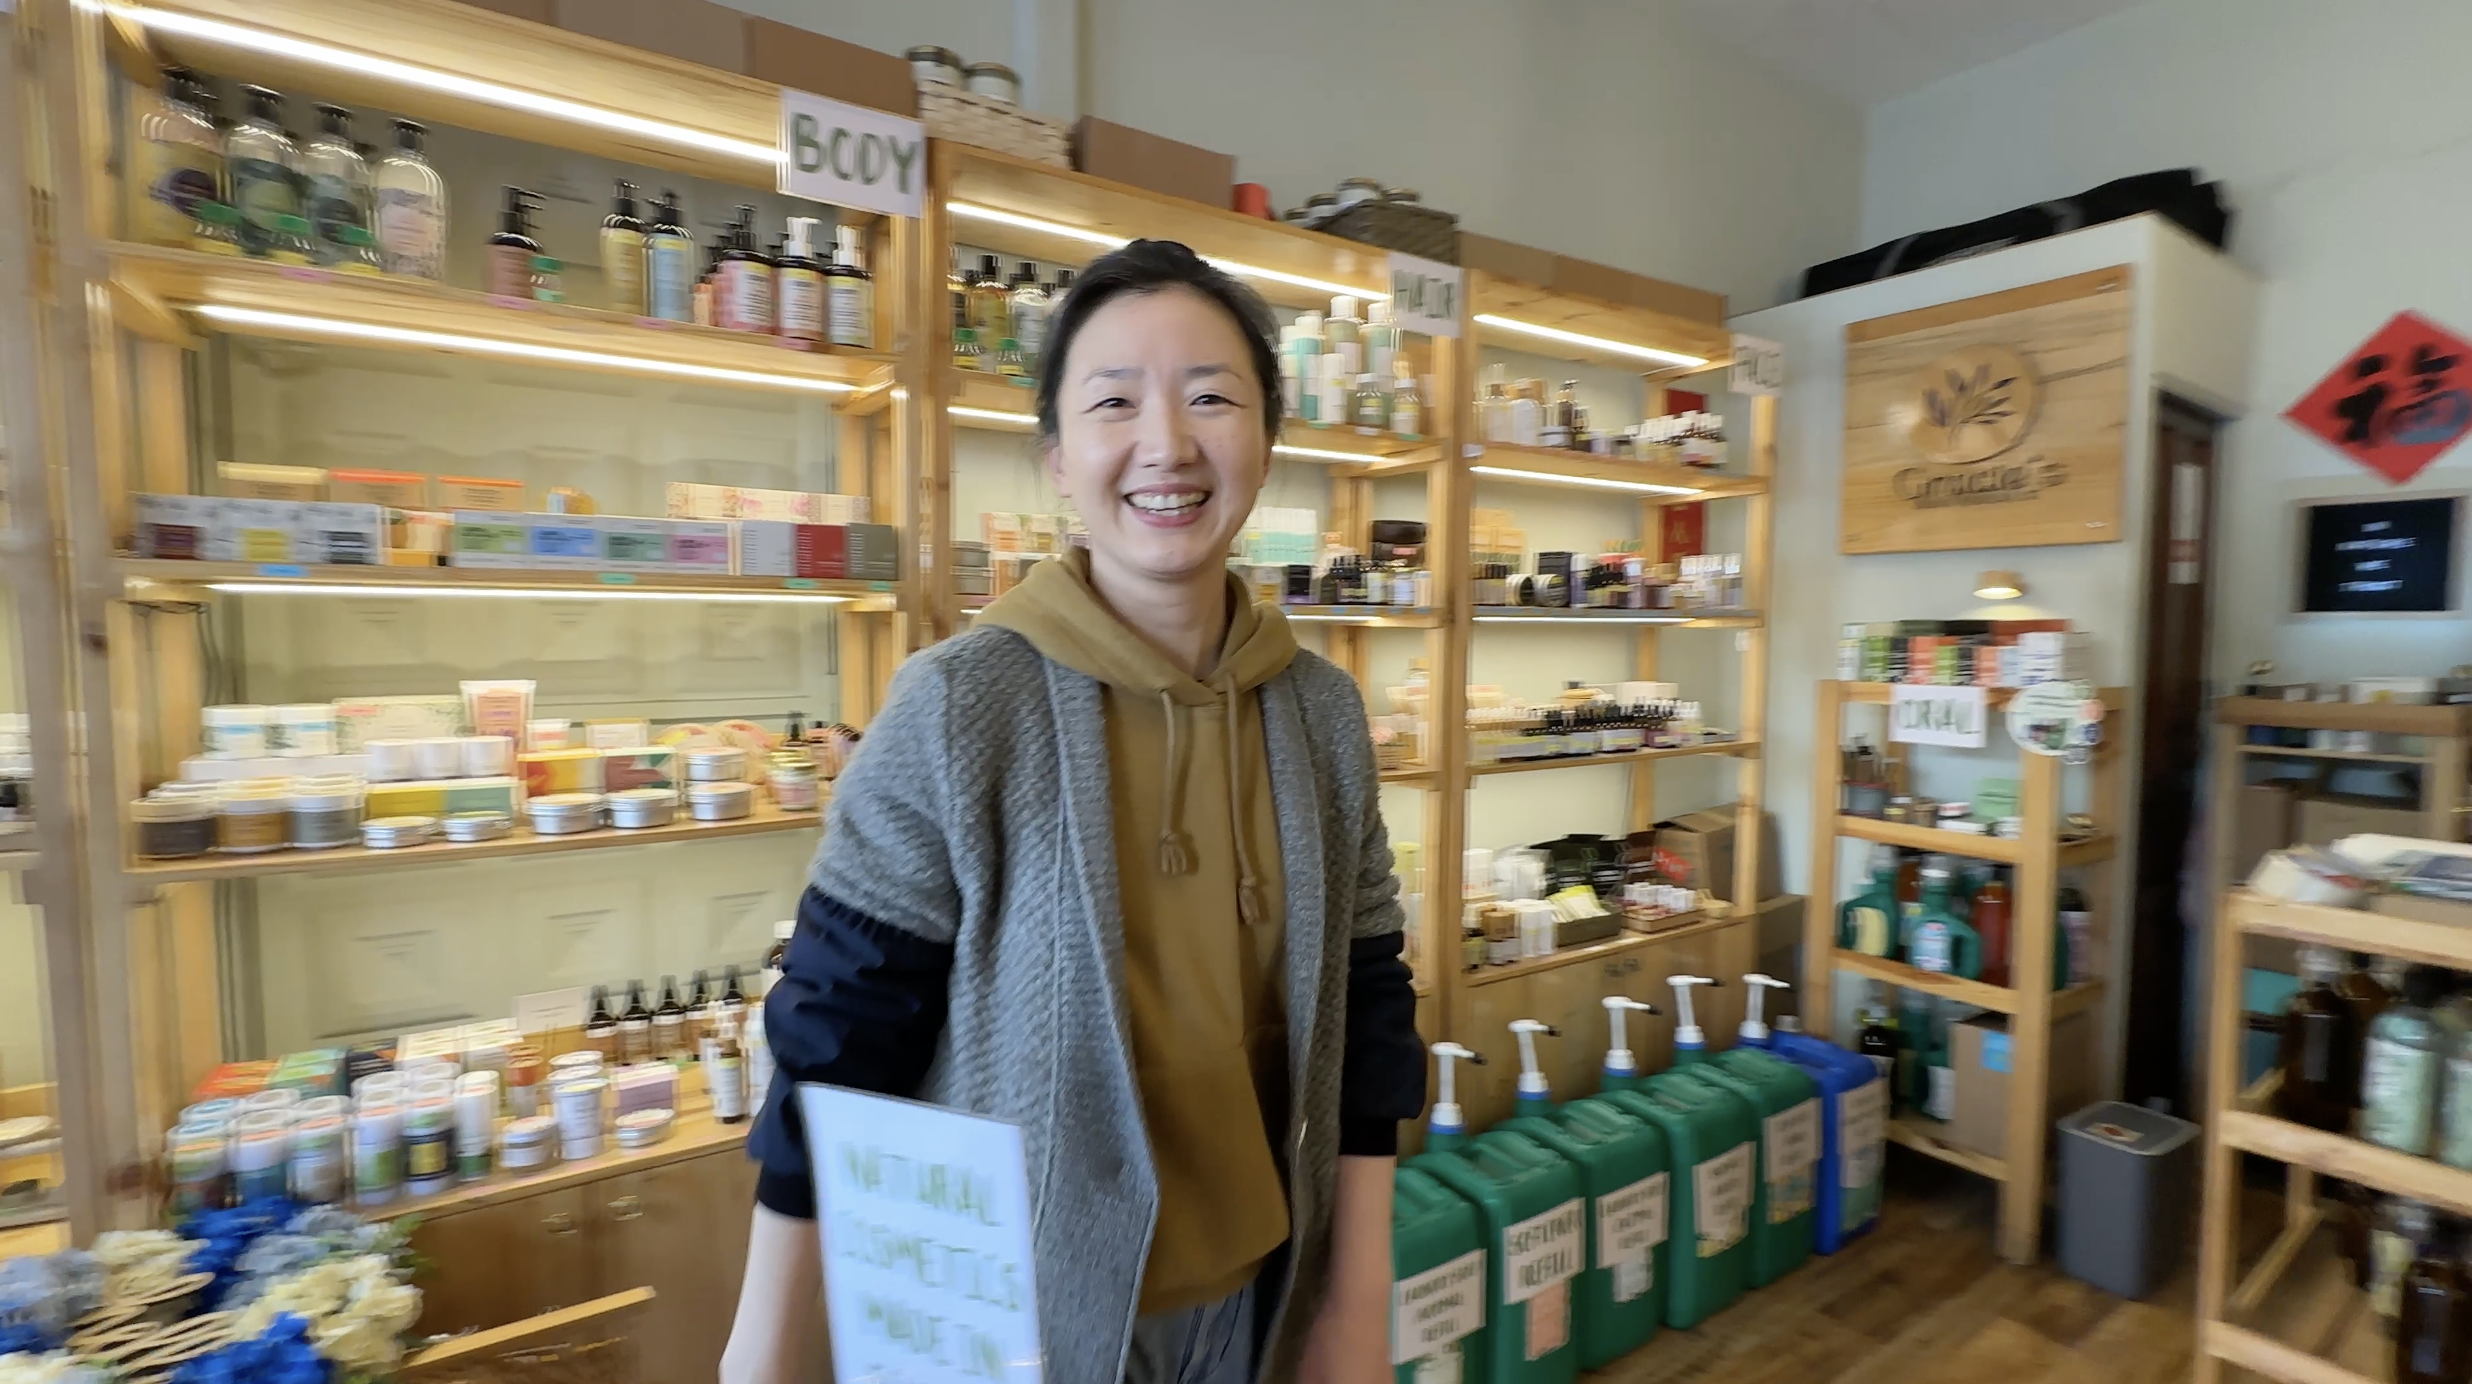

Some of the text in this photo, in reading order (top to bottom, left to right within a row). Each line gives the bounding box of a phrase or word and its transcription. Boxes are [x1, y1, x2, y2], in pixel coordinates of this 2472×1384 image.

[789, 111, 921, 195] BODY
[2330, 343, 2471, 446] 福
[1891, 454, 2069, 500] Gracie's
